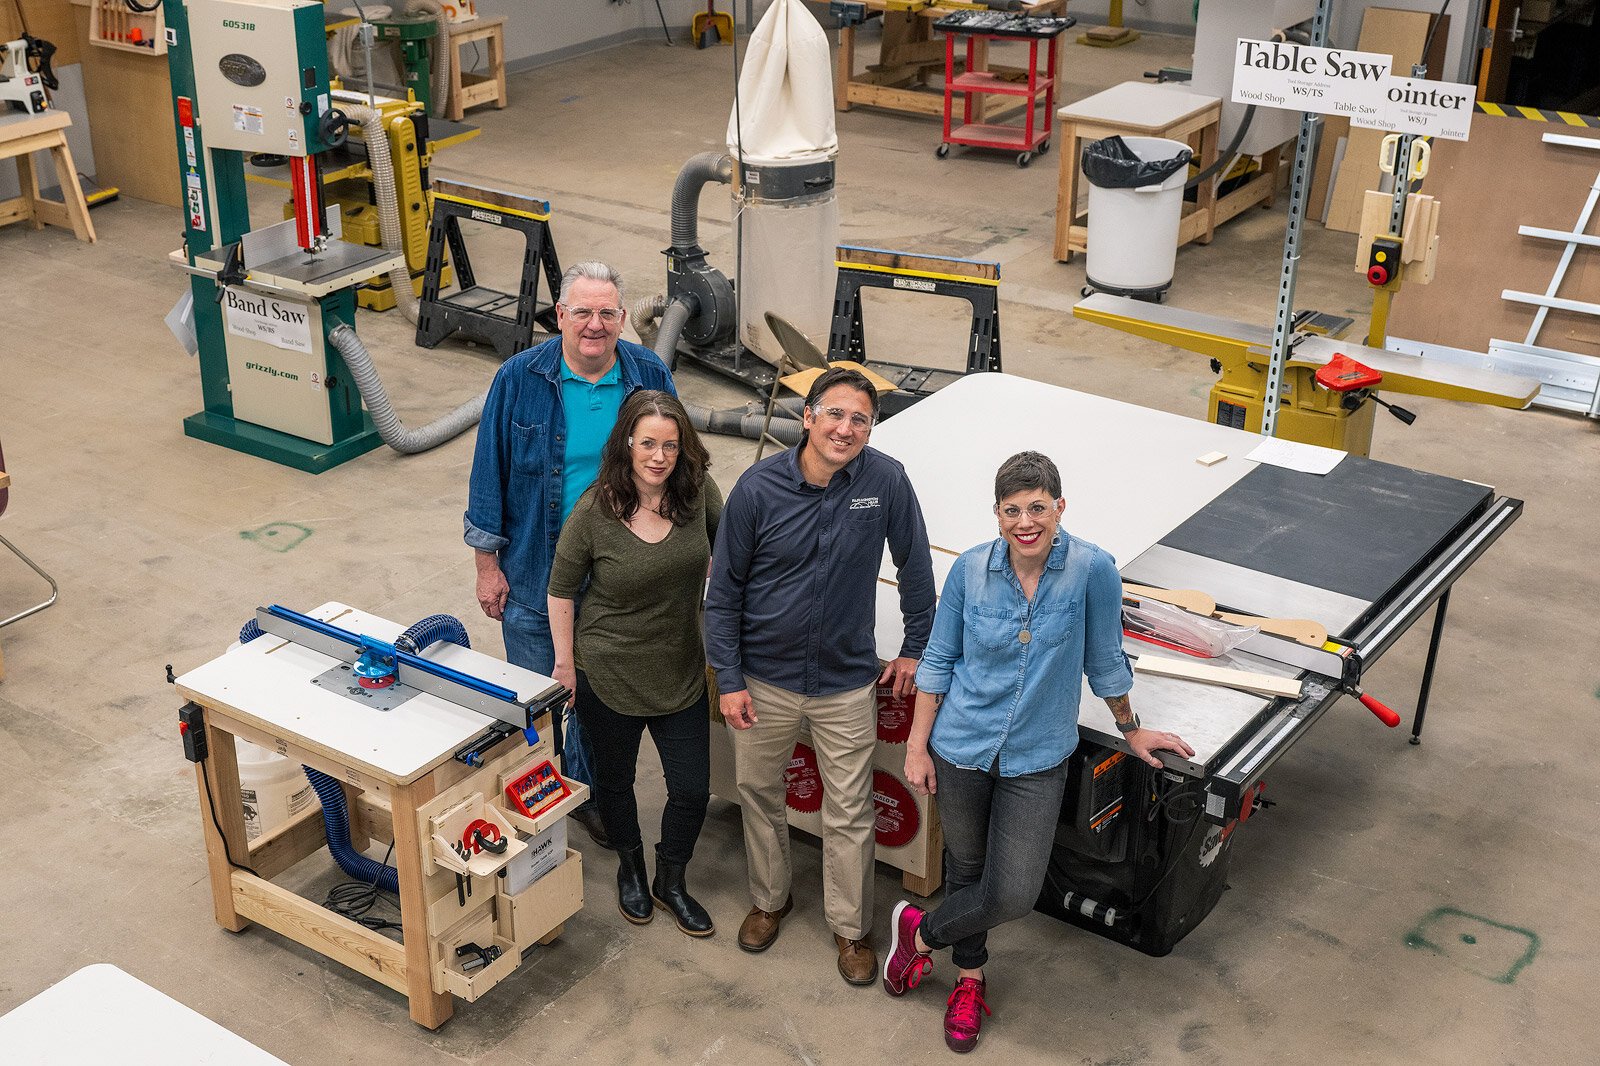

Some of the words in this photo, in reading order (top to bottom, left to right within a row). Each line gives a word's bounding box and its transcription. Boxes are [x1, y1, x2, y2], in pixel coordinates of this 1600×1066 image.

[1239, 40, 1318, 75] Table
[1324, 50, 1388, 82] Saw
[1240, 89, 1263, 101] Wood
[1264, 93, 1286, 105] Shop
[1292, 86, 1324, 98] WS/TS
[1387, 82, 1467, 110] ointer
[1334, 101, 1357, 112] Table
[1358, 105, 1378, 115] Saw
[1356, 117, 1377, 127] Wood
[1378, 120, 1397, 130] Shop
[1407, 115, 1428, 126] WS/J
[1440, 128, 1466, 138] Jointer
[226, 290, 268, 318] Band
[271, 302, 306, 326] Saw
[281, 337, 294, 346] Band
[245, 361, 299, 381] grizzly.com
